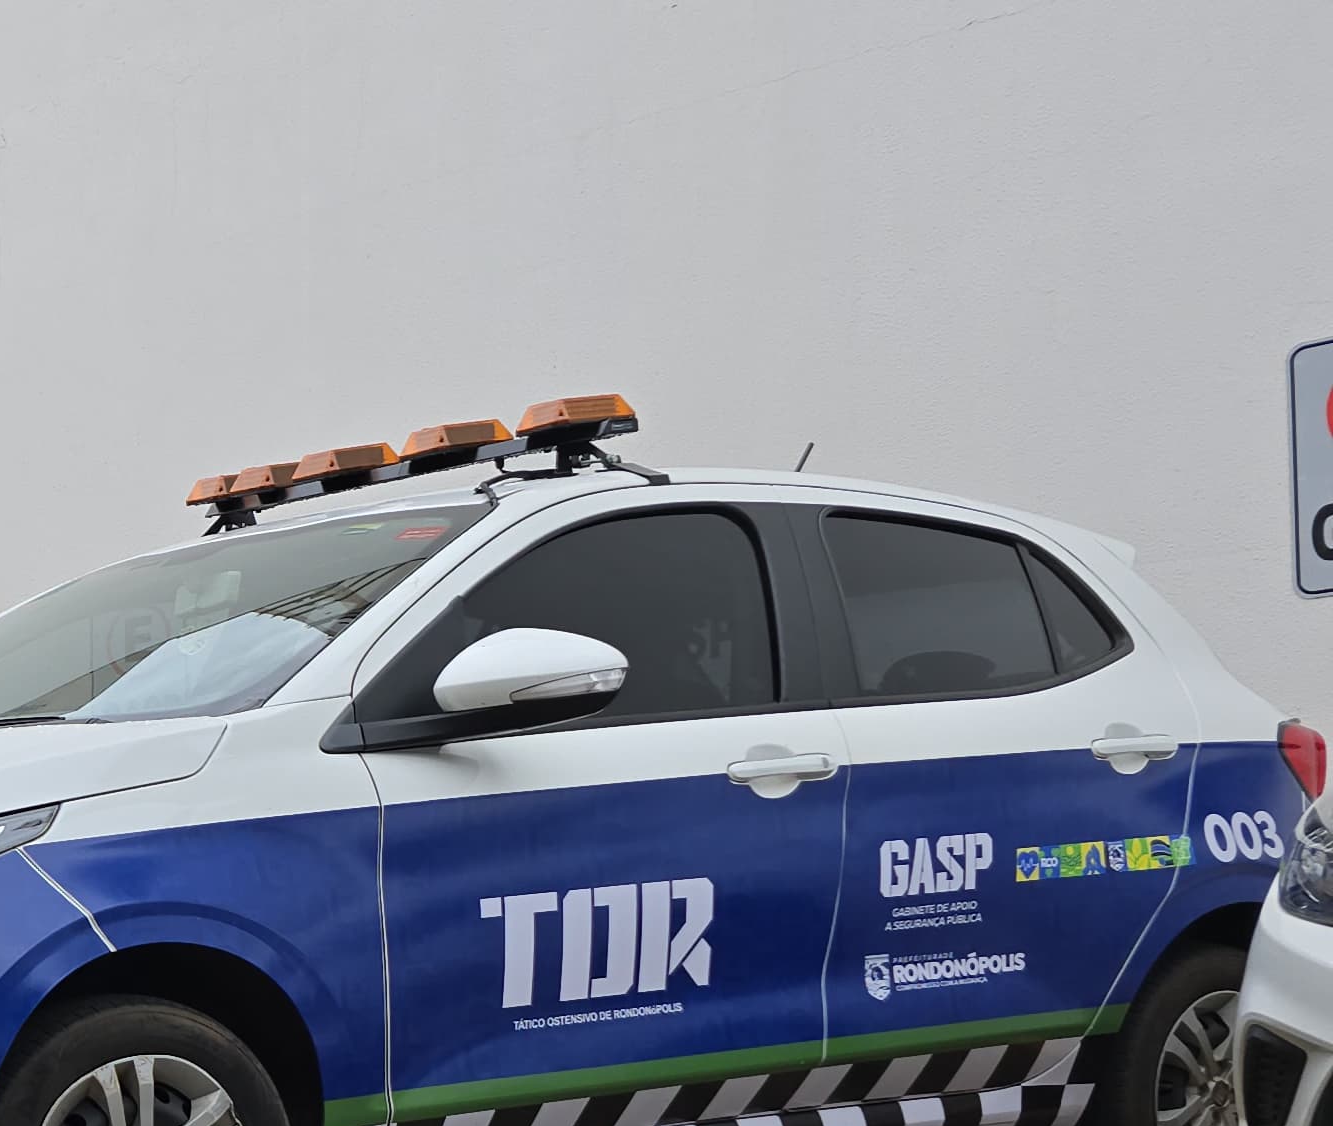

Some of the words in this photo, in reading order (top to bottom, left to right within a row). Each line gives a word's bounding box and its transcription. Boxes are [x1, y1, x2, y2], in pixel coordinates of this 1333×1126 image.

[1203, 810, 1284, 863] 003
[879, 832, 993, 898] GASP
[892, 904, 935, 918] GABINETE
[936, 902, 949, 913] DE
[950, 900, 978, 911] APOIO
[892, 916, 945, 931] SEGURANÇA
[947, 913, 983, 925] PÚBLICA
[479, 877, 714, 1009] TOR
[892, 952, 1026, 984] RONDONÓPOLIS
[513, 1018, 545, 1031] TÁTICO
[547, 1012, 598, 1027] OSTENSIVO
[599, 1010, 612, 1021] DE
